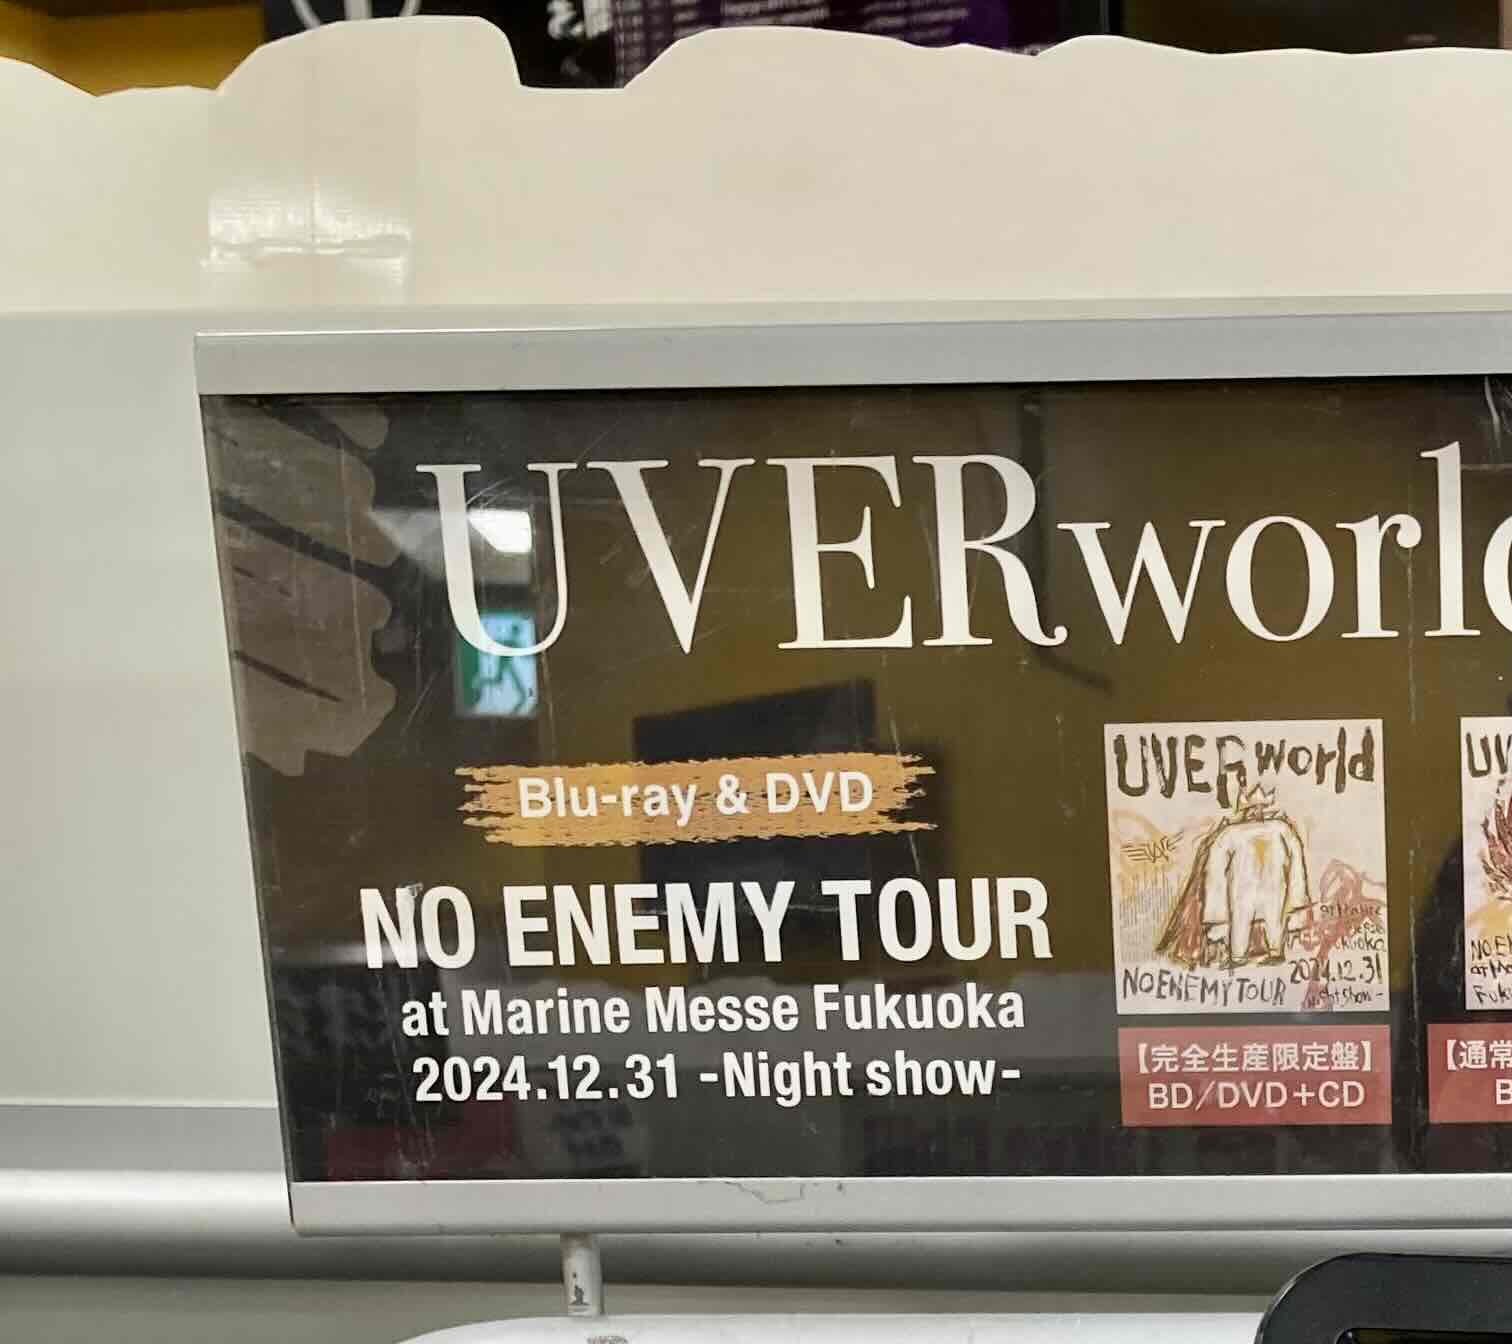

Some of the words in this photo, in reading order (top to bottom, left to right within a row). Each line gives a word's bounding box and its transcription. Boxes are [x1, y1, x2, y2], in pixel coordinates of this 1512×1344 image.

[1113, 726, 1376, 810] UVERworld
[518, 776, 697, 827] Blu-ray
[717, 778, 750, 816] &
[766, 770, 875, 815] DVD
[359, 885, 475, 971] NO
[504, 879, 796, 967] ENEMY
[821, 876, 1054, 961] TOUR
[402, 995, 448, 1038] at
[462, 988, 632, 1036] Marine
[646, 986, 800, 1035] Messe
[814, 981, 1026, 1031] Fukuoka
[412, 1053, 679, 1103] 2024.12.31
[699, 1049, 852, 1107] -Night
[867, 1049, 1022, 1099] show-
[1137, 1040, 1374, 1074] 【完全生産限定盤】
